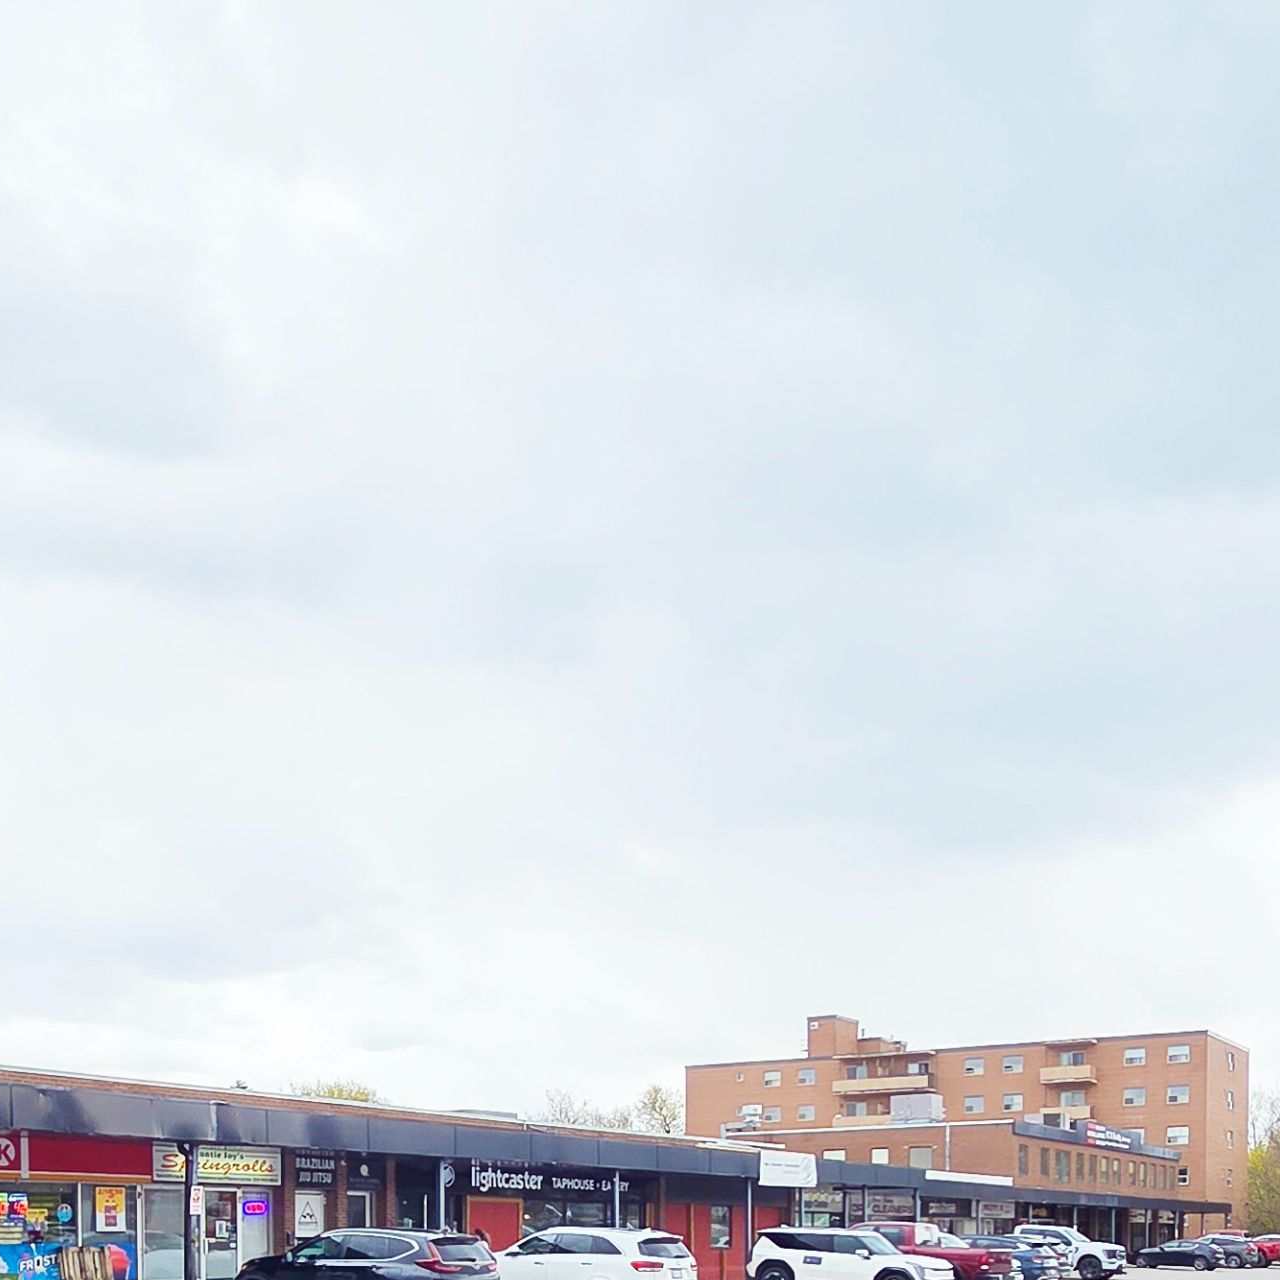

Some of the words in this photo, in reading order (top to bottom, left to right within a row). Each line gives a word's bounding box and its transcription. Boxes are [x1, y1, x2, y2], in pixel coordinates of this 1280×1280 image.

[296, 1157, 335, 1169] BRAZILIAN
[471, 1167, 543, 1192] lightcaster
[552, 1177, 595, 1190] TAPHOUSE
[601, 1178, 629, 1192] EARY
[20, 1254, 58, 1273] FROST
